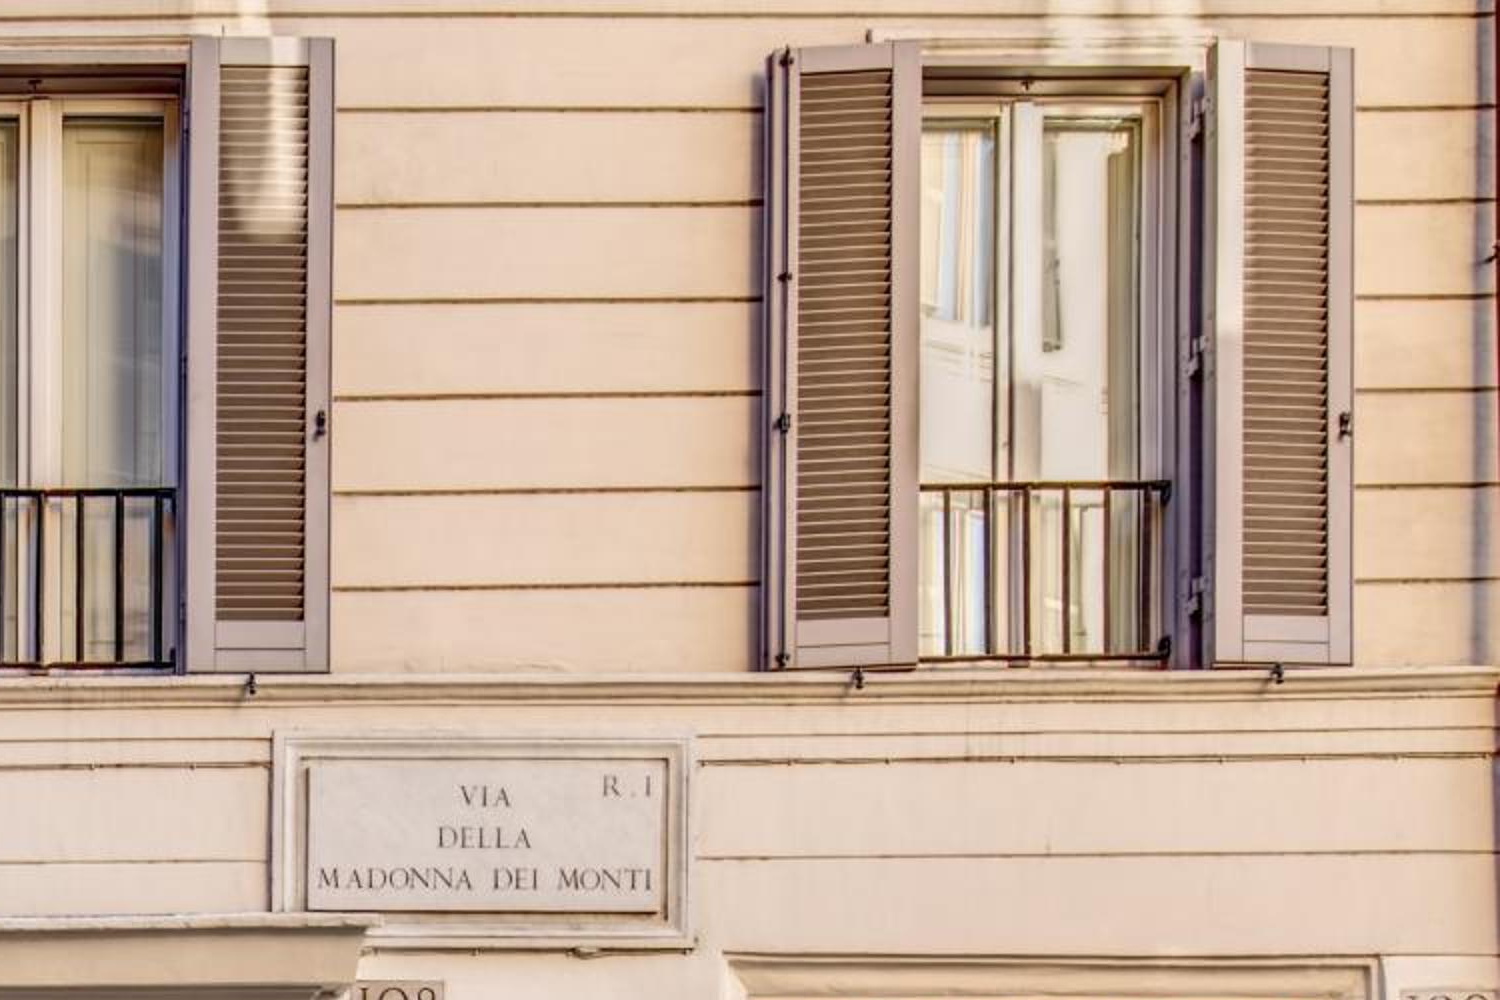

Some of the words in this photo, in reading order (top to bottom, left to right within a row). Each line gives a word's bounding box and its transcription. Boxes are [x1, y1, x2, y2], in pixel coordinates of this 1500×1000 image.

[460, 785, 511, 807] VIA
[437, 826, 532, 849] DELLA
[317, 867, 473, 892] MADONNA
[493, 867, 539, 891] DEI
[557, 867, 652, 891] MONTI
